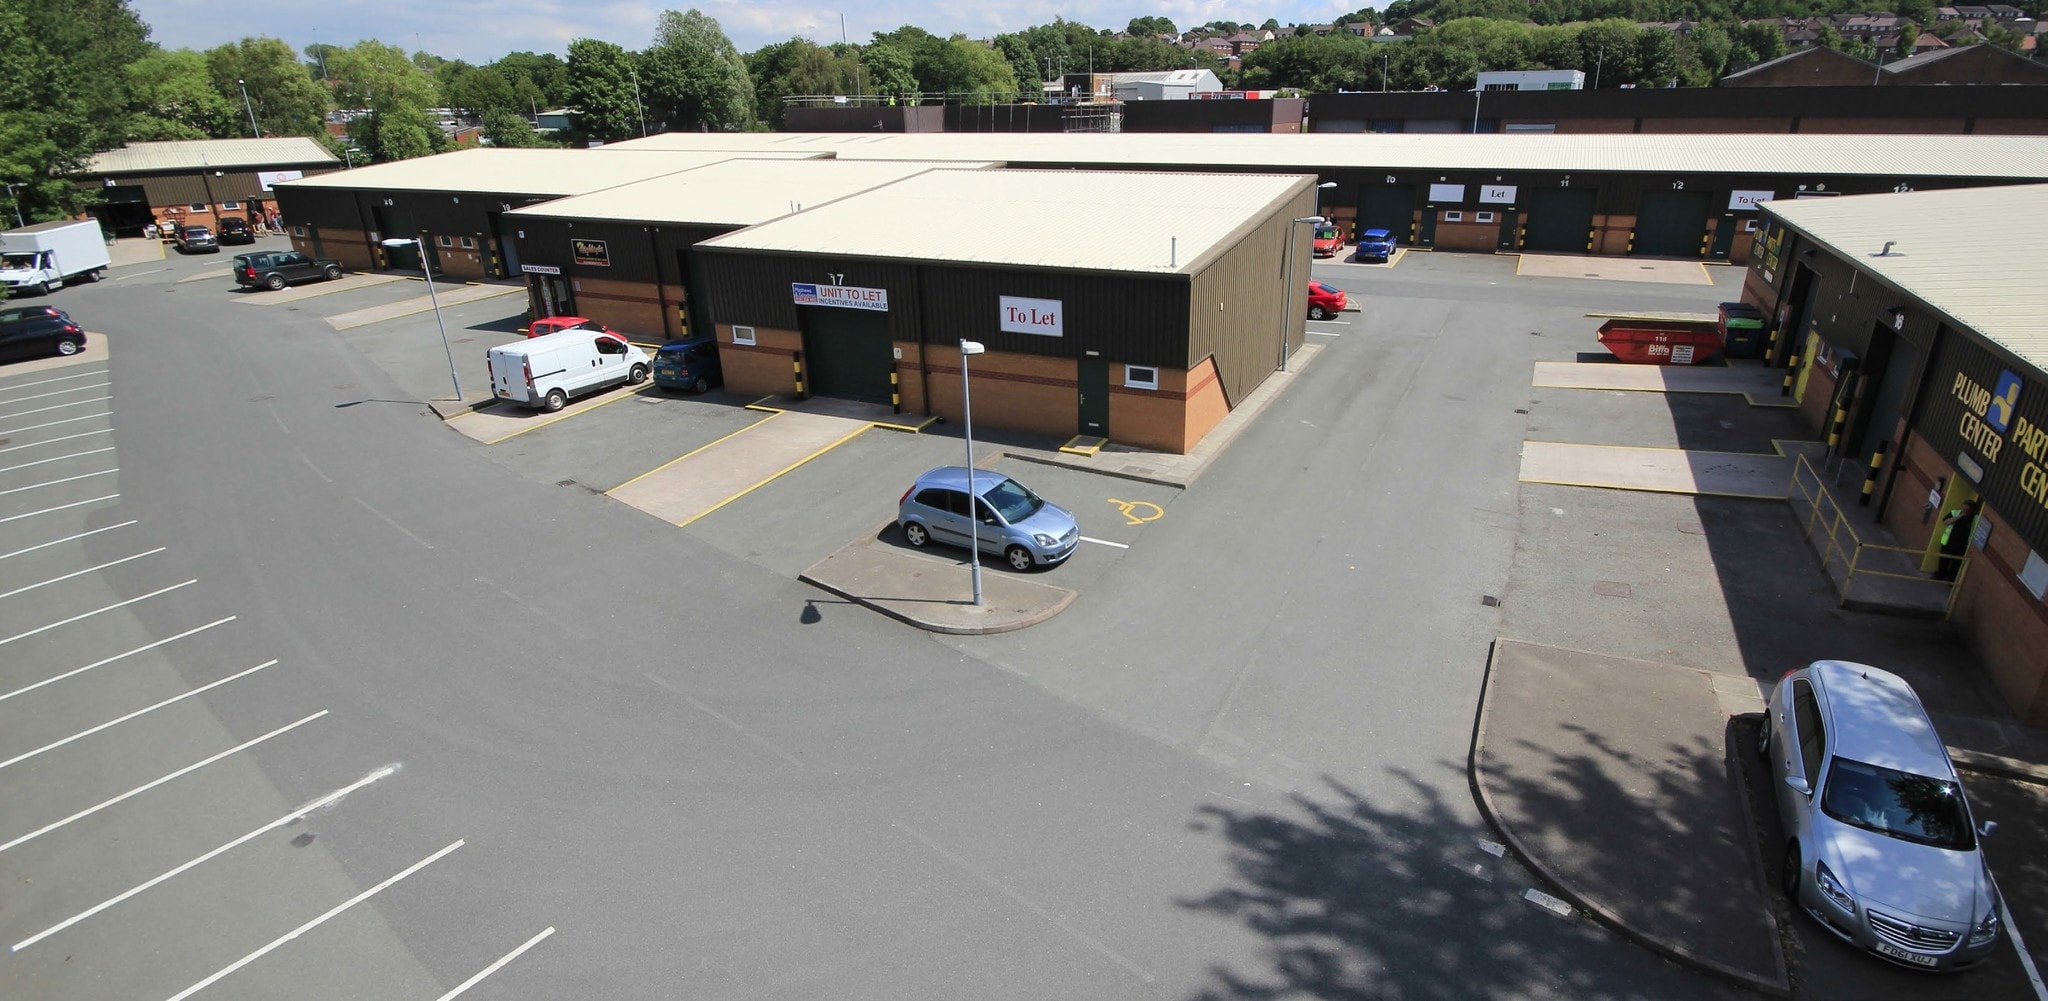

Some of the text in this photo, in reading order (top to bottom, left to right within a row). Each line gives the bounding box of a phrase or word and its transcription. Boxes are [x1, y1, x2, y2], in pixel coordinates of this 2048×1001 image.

[1491, 189, 1505, 198] Let
[1738, 196, 1748, 204] To
[831, 273, 844, 285] 17
[820, 287, 843, 299] UNIT
[845, 289, 860, 300] TO
[862, 291, 882, 302] LET
[819, 298, 888, 310] INCENTIVES AVAILABLE
[1006, 306, 1056, 326] To Let
[1894, 313, 1904, 330] 16
[1952, 371, 1991, 417] PLUMB
[1960, 411, 2003, 463] CENTER
[2012, 416, 2048, 469] PART
[2021, 461, 2048, 510] CEN
